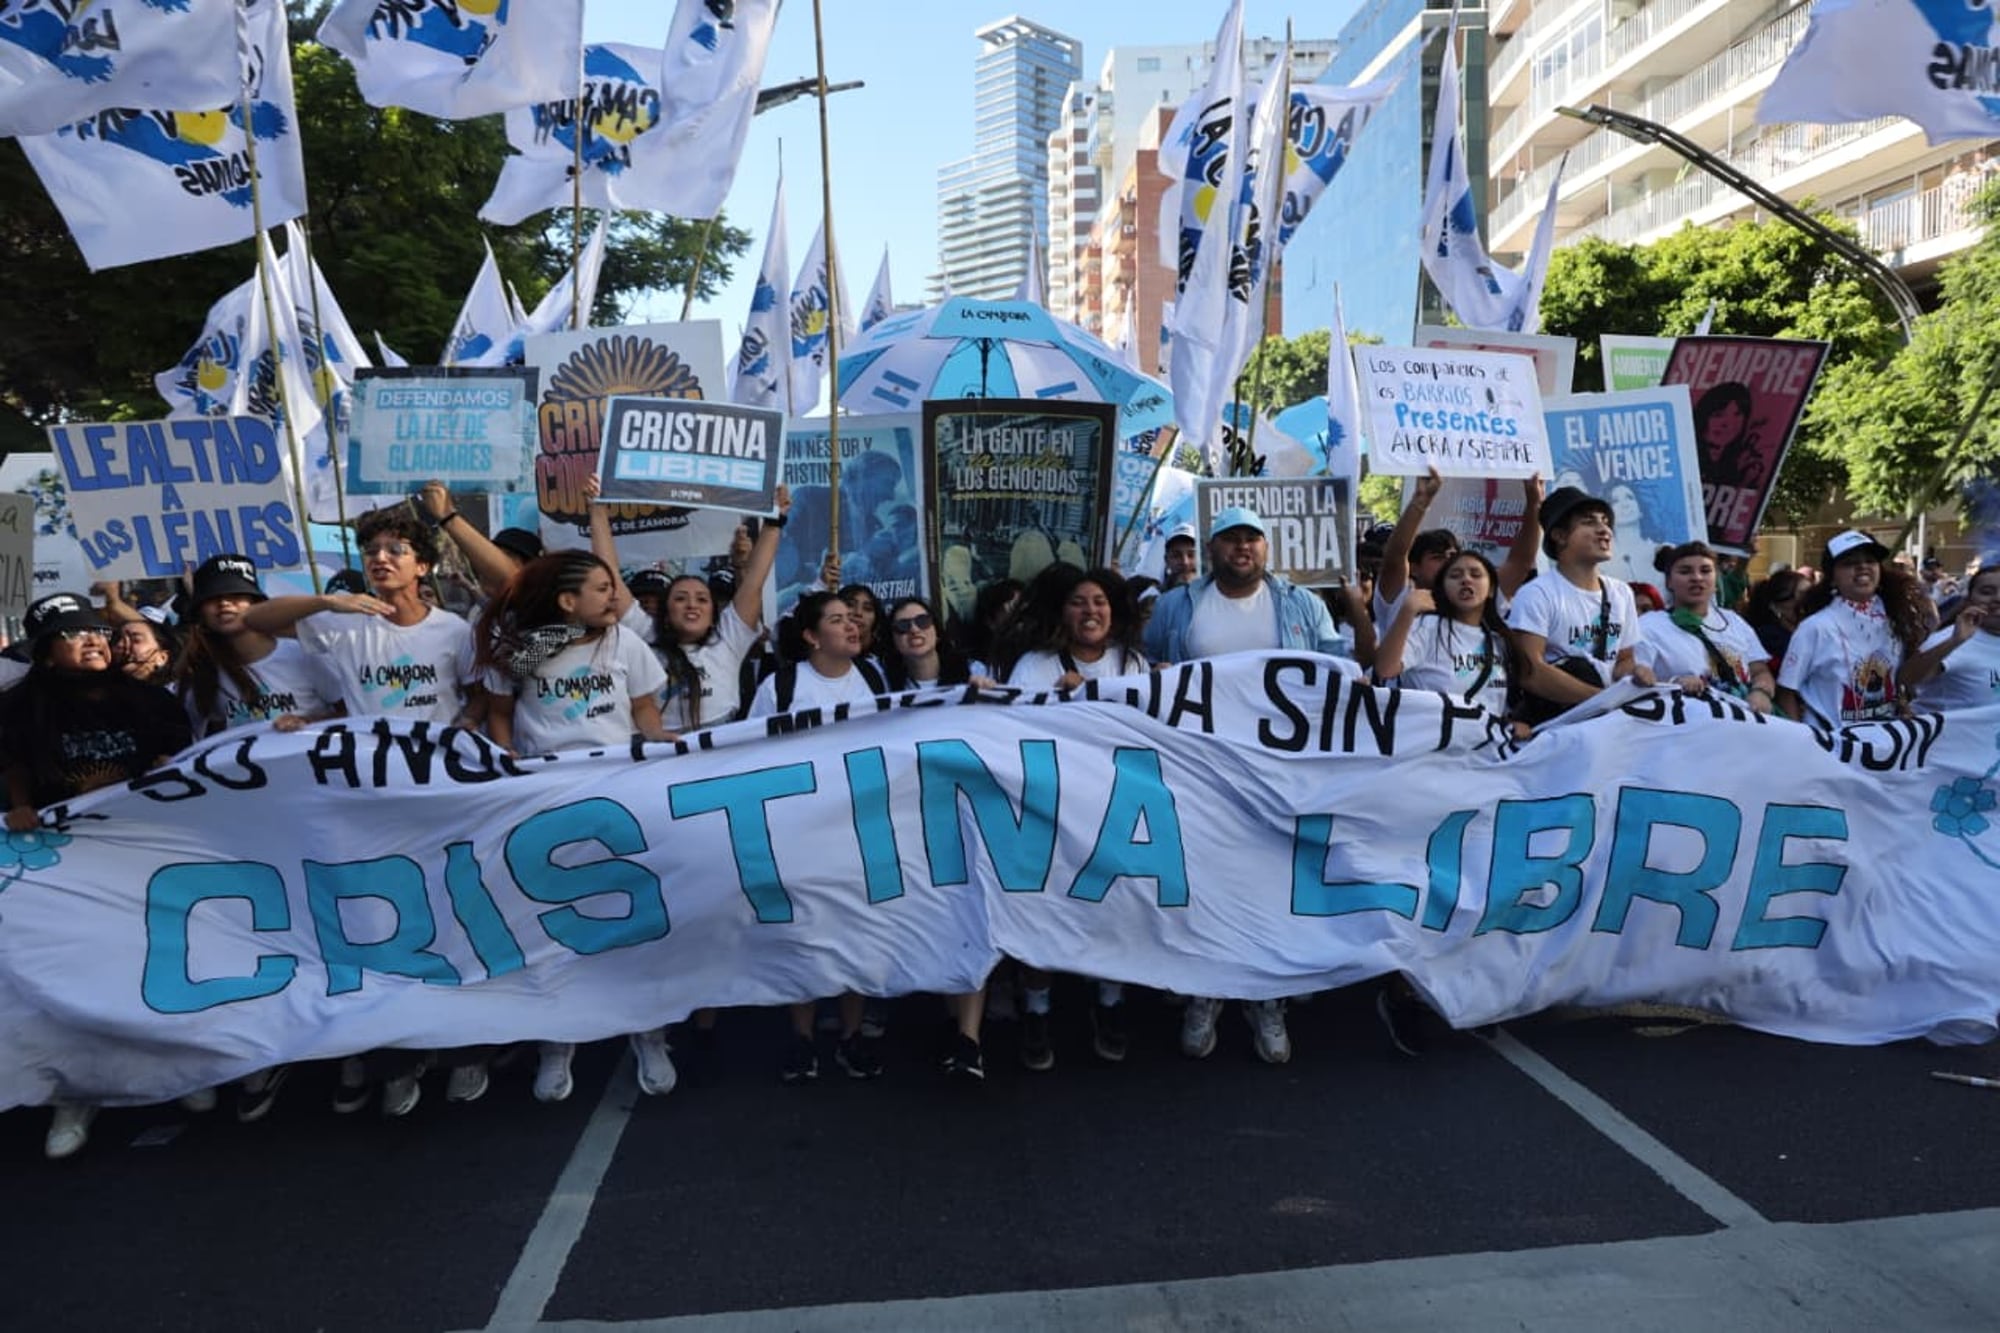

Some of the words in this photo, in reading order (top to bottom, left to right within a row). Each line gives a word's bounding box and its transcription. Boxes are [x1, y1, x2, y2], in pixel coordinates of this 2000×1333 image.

[1669, 345, 1816, 395] SIEMPRE
[379, 390, 510, 407] DEFENDAMOS
[396, 413, 419, 440] LA
[425, 414, 459, 440] LEY
[464, 413, 489, 440] DE
[619, 409, 767, 460] CRISTINA
[1394, 402, 1518, 436] Presentes
[1564, 415, 1593, 450] EL
[1598, 409, 1669, 447] AMOR
[53, 416, 282, 491] LEALTAD
[388, 443, 492, 472] GLACIARES
[962, 427, 984, 454] LA
[989, 428, 1046, 455] GENTE
[1052, 430, 1075, 456] EN
[617, 452, 762, 488] LIBRE
[956, 466, 985, 491] LOS
[988, 466, 1080, 493] GENOCIDAS
[1594, 444, 1674, 484] VENCE
[162, 484, 184, 511] A
[1209, 486, 1306, 517] DEFENDER
[1312, 485, 1337, 515] LA
[130, 501, 300, 576] LEALES
[1263, 516, 1343, 571] TRIA
[360, 664, 374, 685] LA
[537, 677, 554, 699] LA
[1258, 658, 1401, 757] SIN
[140, 738, 1191, 1014] CRISTINA
[1290, 786, 1848, 952] LIBRE
